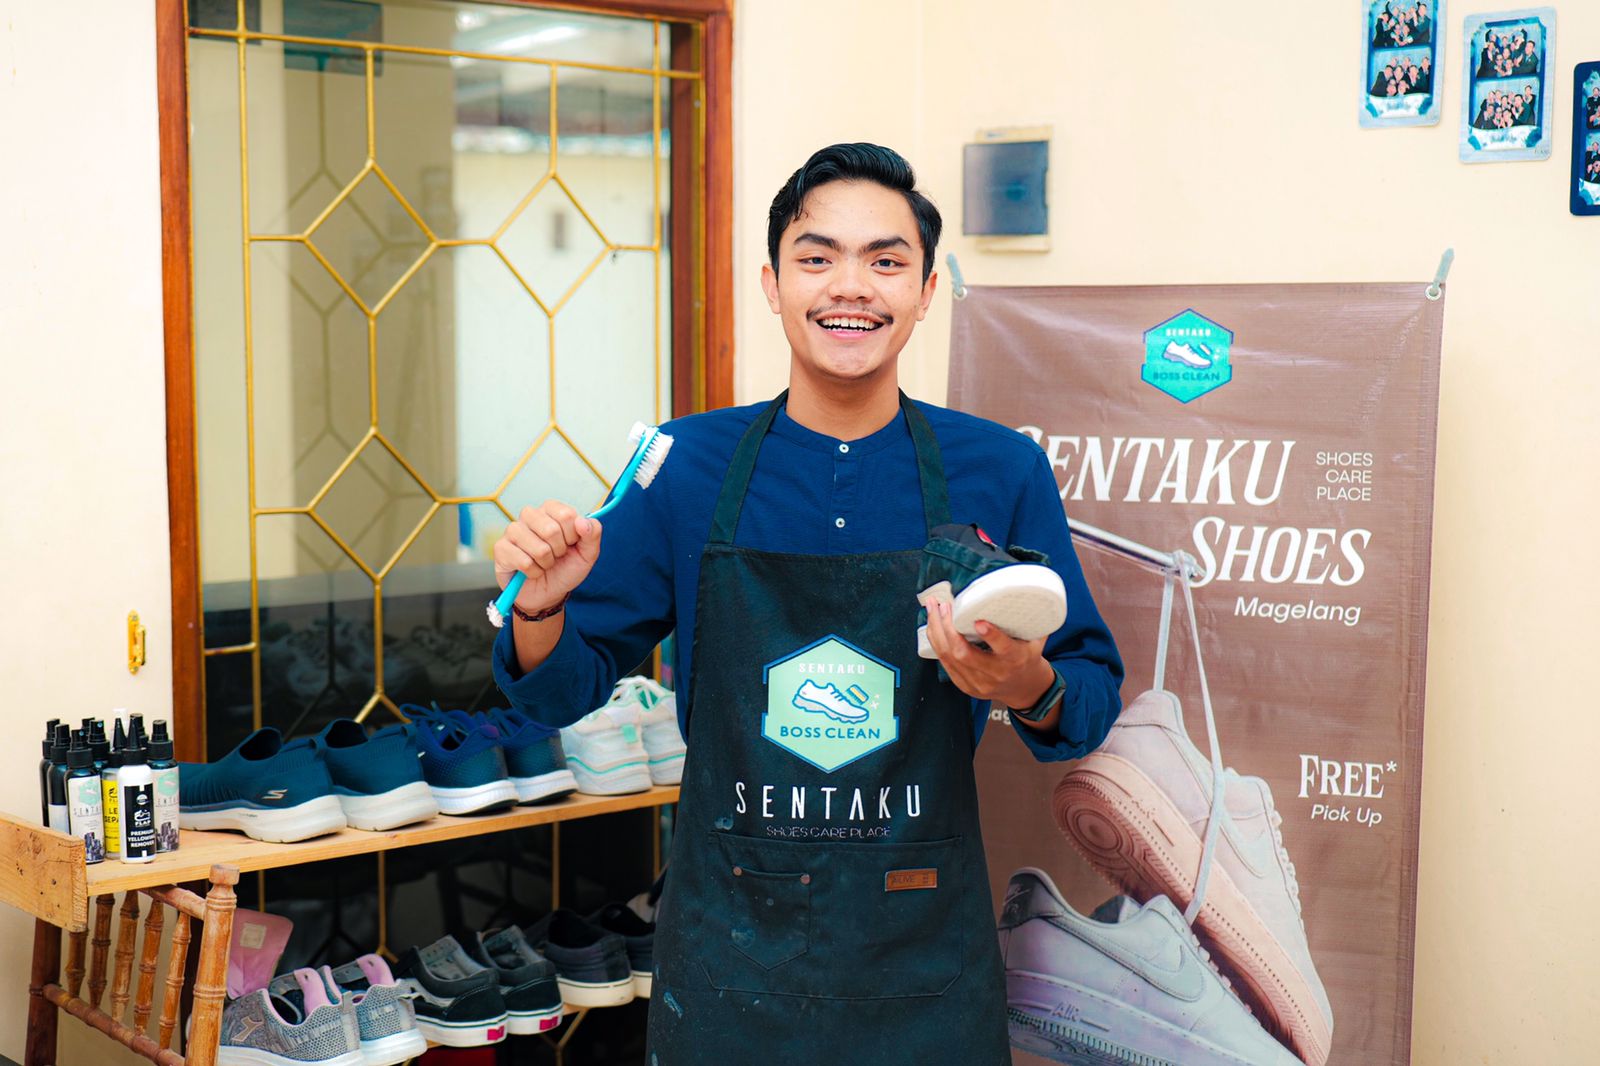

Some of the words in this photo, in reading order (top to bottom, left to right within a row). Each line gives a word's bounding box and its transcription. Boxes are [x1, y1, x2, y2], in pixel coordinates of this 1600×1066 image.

[1165, 328, 1211, 337] SENTAKU
[1153, 372, 1180, 381] BOSS
[1182, 372, 1220, 381] CLEAN
[1316, 451, 1373, 467] SHOES
[1325, 469, 1372, 484] CARE
[1316, 486, 1371, 501] PLACE
[1190, 516, 1372, 588] SHOES
[1234, 596, 1361, 626] Magelang
[798, 663, 865, 674] SENTAKU
[780, 726, 821, 738] BOSS
[825, 727, 880, 739] CLEAN
[735, 781, 921, 820] SENTAKU
[1311, 804, 1350, 822] Pick
[1356, 807, 1382, 828] Up
[766, 825, 807, 838] SHOES
[810, 827, 847, 838] CARE
[850, 826, 892, 838] PLACE
